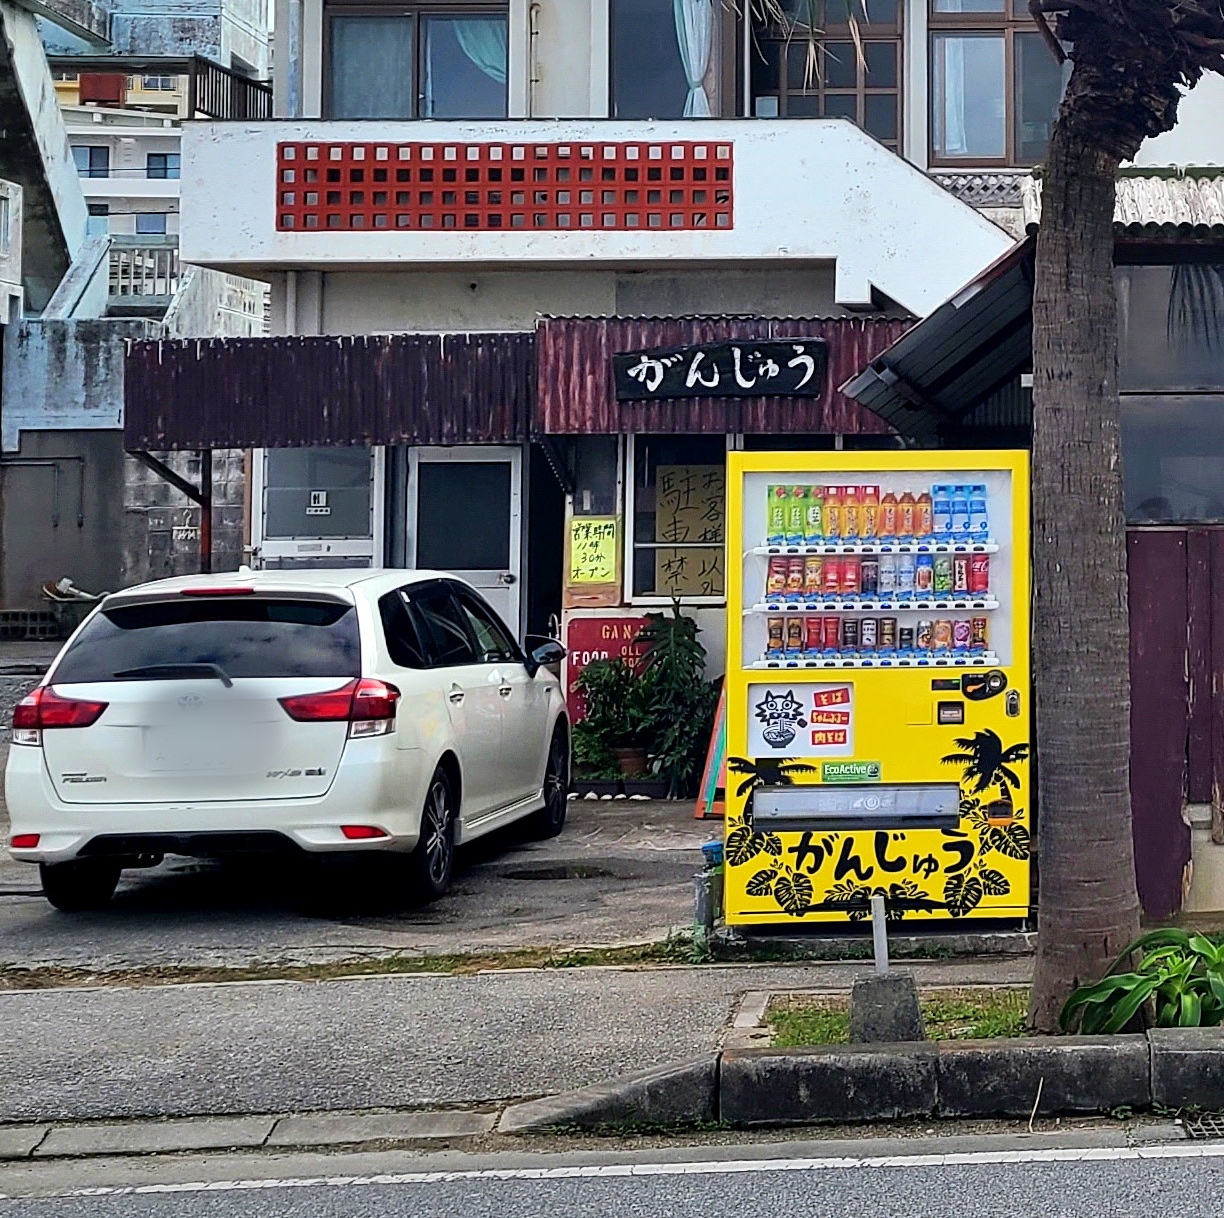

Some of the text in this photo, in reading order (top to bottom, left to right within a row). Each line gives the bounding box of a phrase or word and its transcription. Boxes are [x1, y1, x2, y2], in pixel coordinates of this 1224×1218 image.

[626, 345, 815, 392] がんじゅう
[572, 523, 615, 541] 営業時間
[581, 552, 606, 564] 30分
[572, 567, 611, 579] オープン
[820, 690, 844, 705] そば
[814, 731, 845, 744] 肉そば
[824, 763, 867, 775] EcoActive
[788, 829, 975, 882] がんじゅう
